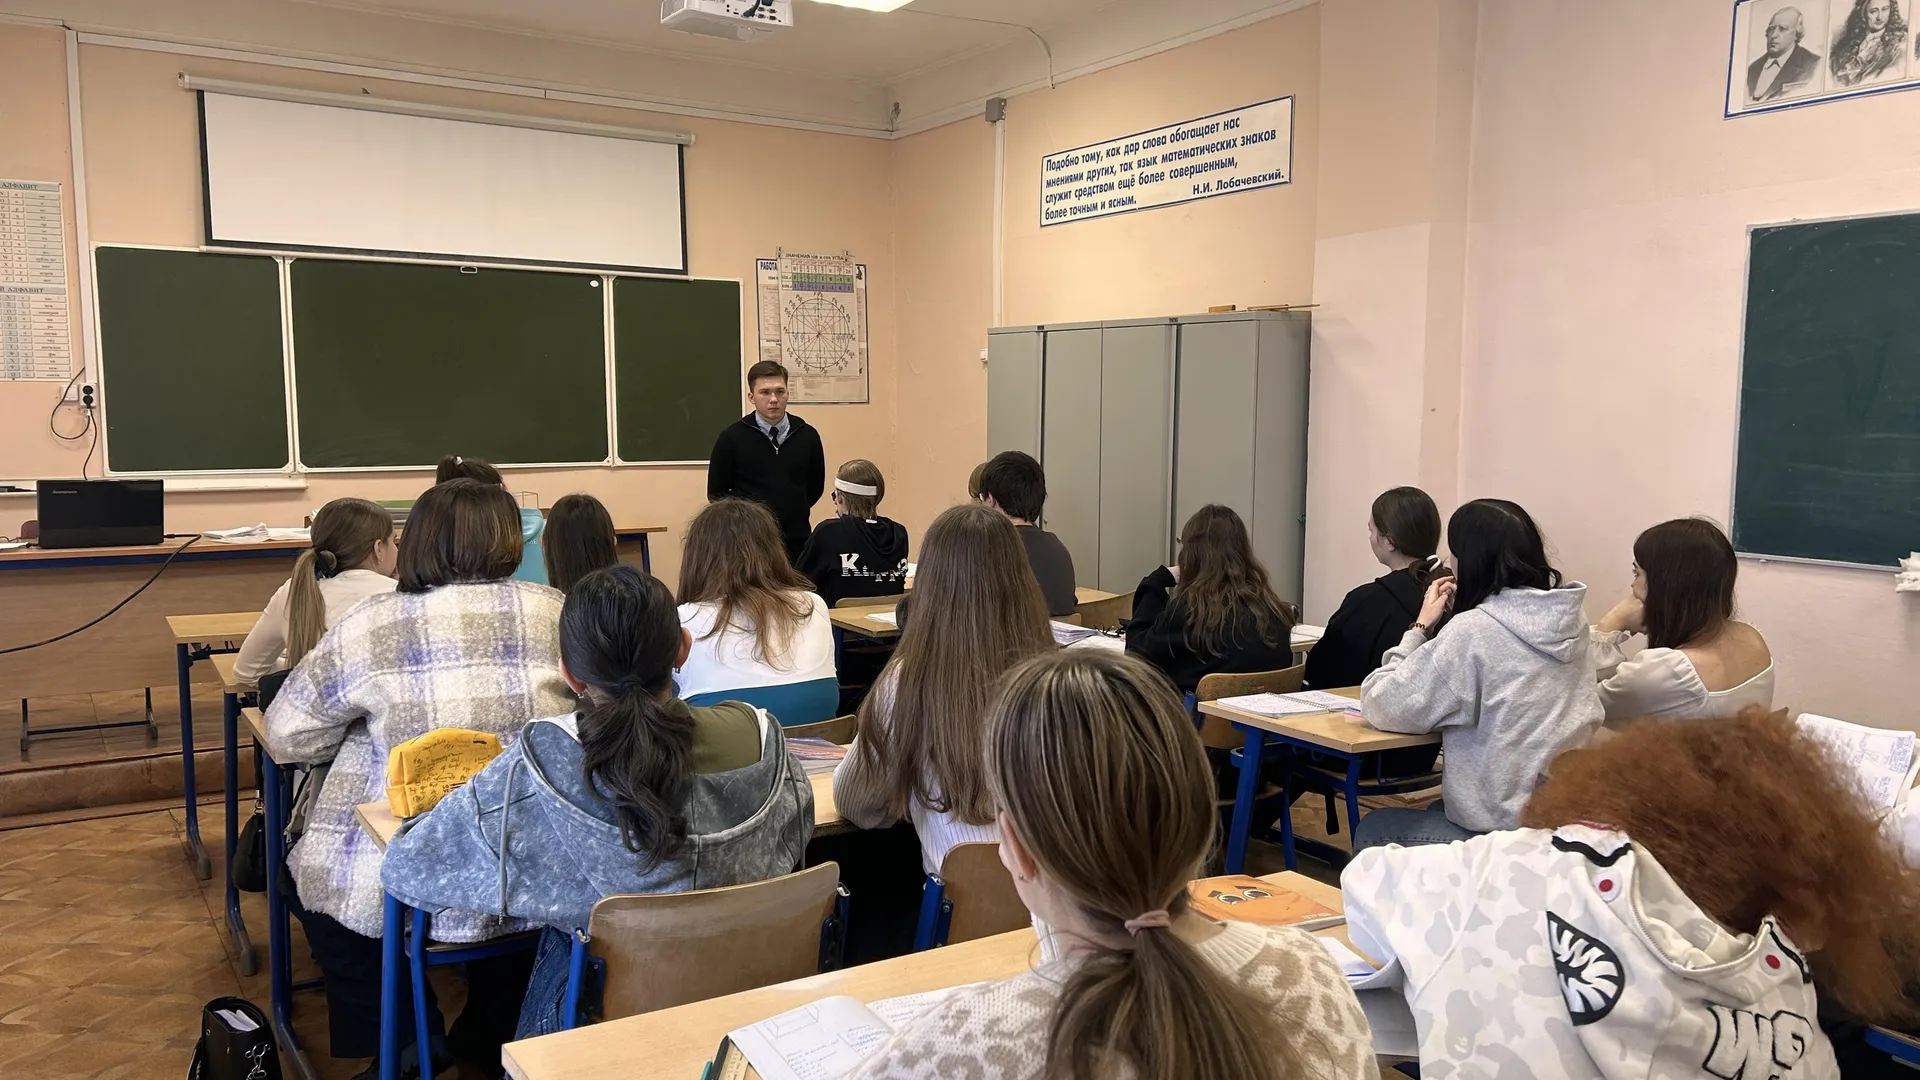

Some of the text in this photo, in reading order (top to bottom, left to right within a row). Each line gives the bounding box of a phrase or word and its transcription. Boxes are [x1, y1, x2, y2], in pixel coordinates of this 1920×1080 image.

[1046, 117, 1240, 172] Подобно тому, как дар слова обогащает нас
[1046, 130, 1276, 188] мнениями других, так язык математических знаков
[1046, 156, 1238, 205] служит средством ещё более совершенным,
[1192, 169, 1284, 195] Н.И. Лобачевский.
[1045, 196, 1136, 220] более точным и ясным.
